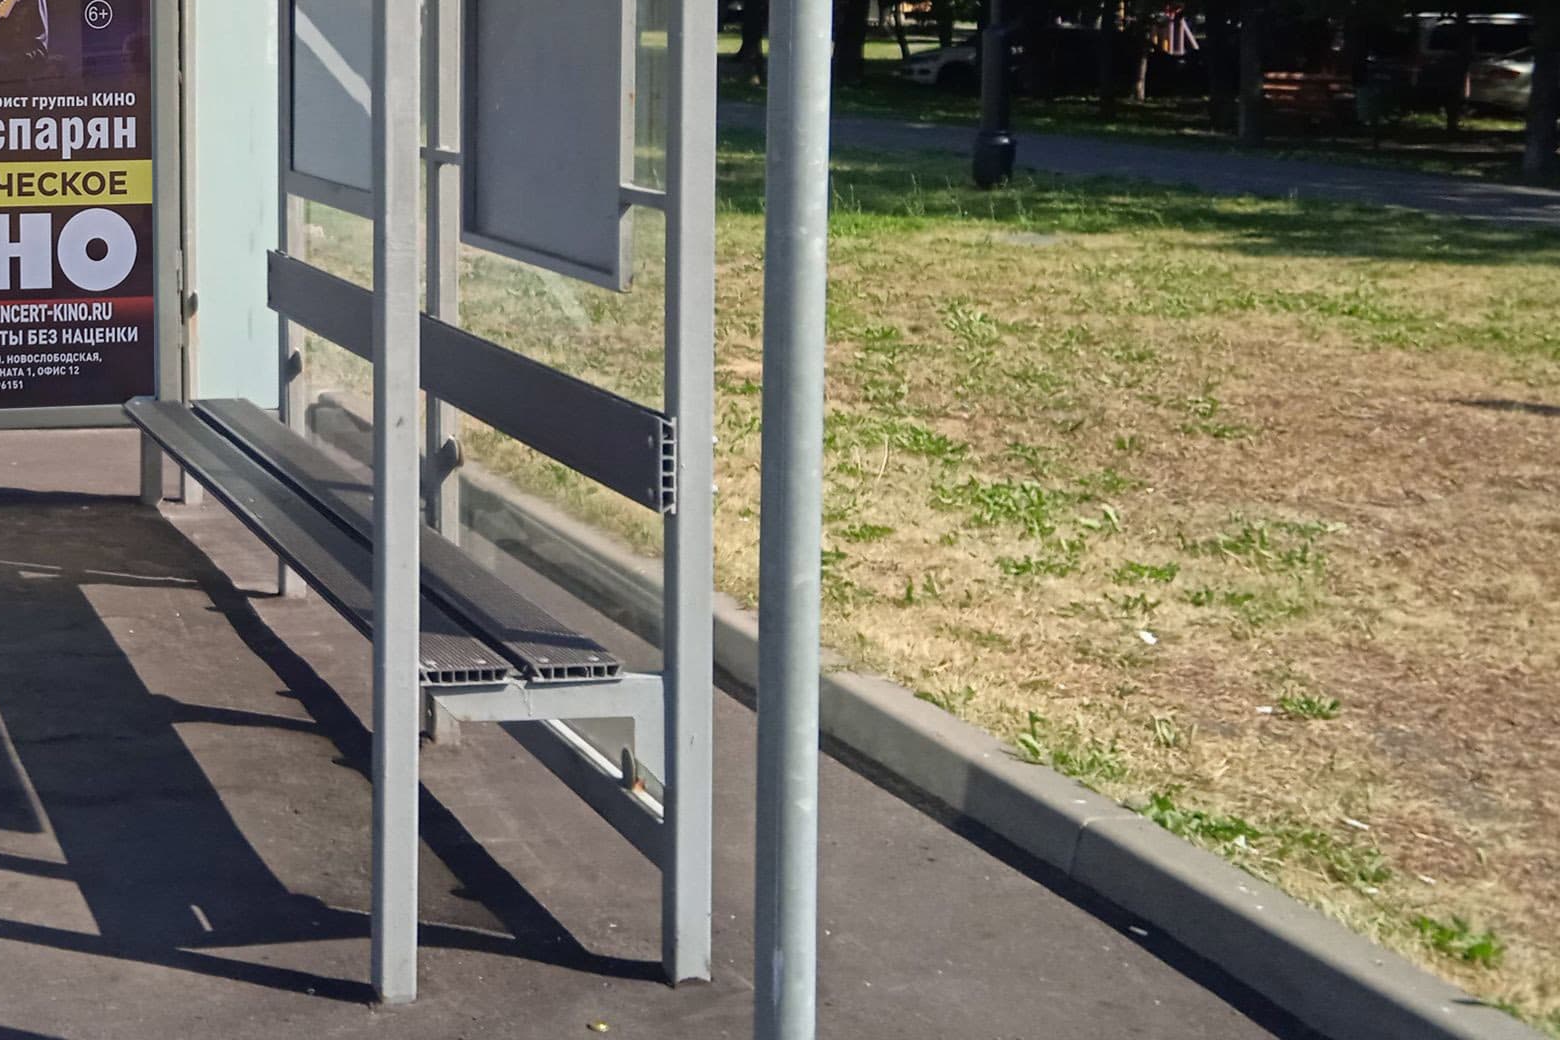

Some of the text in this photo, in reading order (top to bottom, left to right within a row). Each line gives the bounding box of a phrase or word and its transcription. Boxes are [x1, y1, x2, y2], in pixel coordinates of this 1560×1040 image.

[88, 5, 111, 22] 6+
[32, 95, 88, 109] группы
[92, 92, 136, 107] КИНО
[27, 329, 58, 345] БЕЗ
[62, 326, 138, 346] НАЦЕНКИ
[6, 352, 102, 365] НОВОСЛОБОДСКАЯ,
[26, 367, 36, 377] 1,
[37, 366, 66, 376] ОФИС
[69, 365, 80, 375] 12
